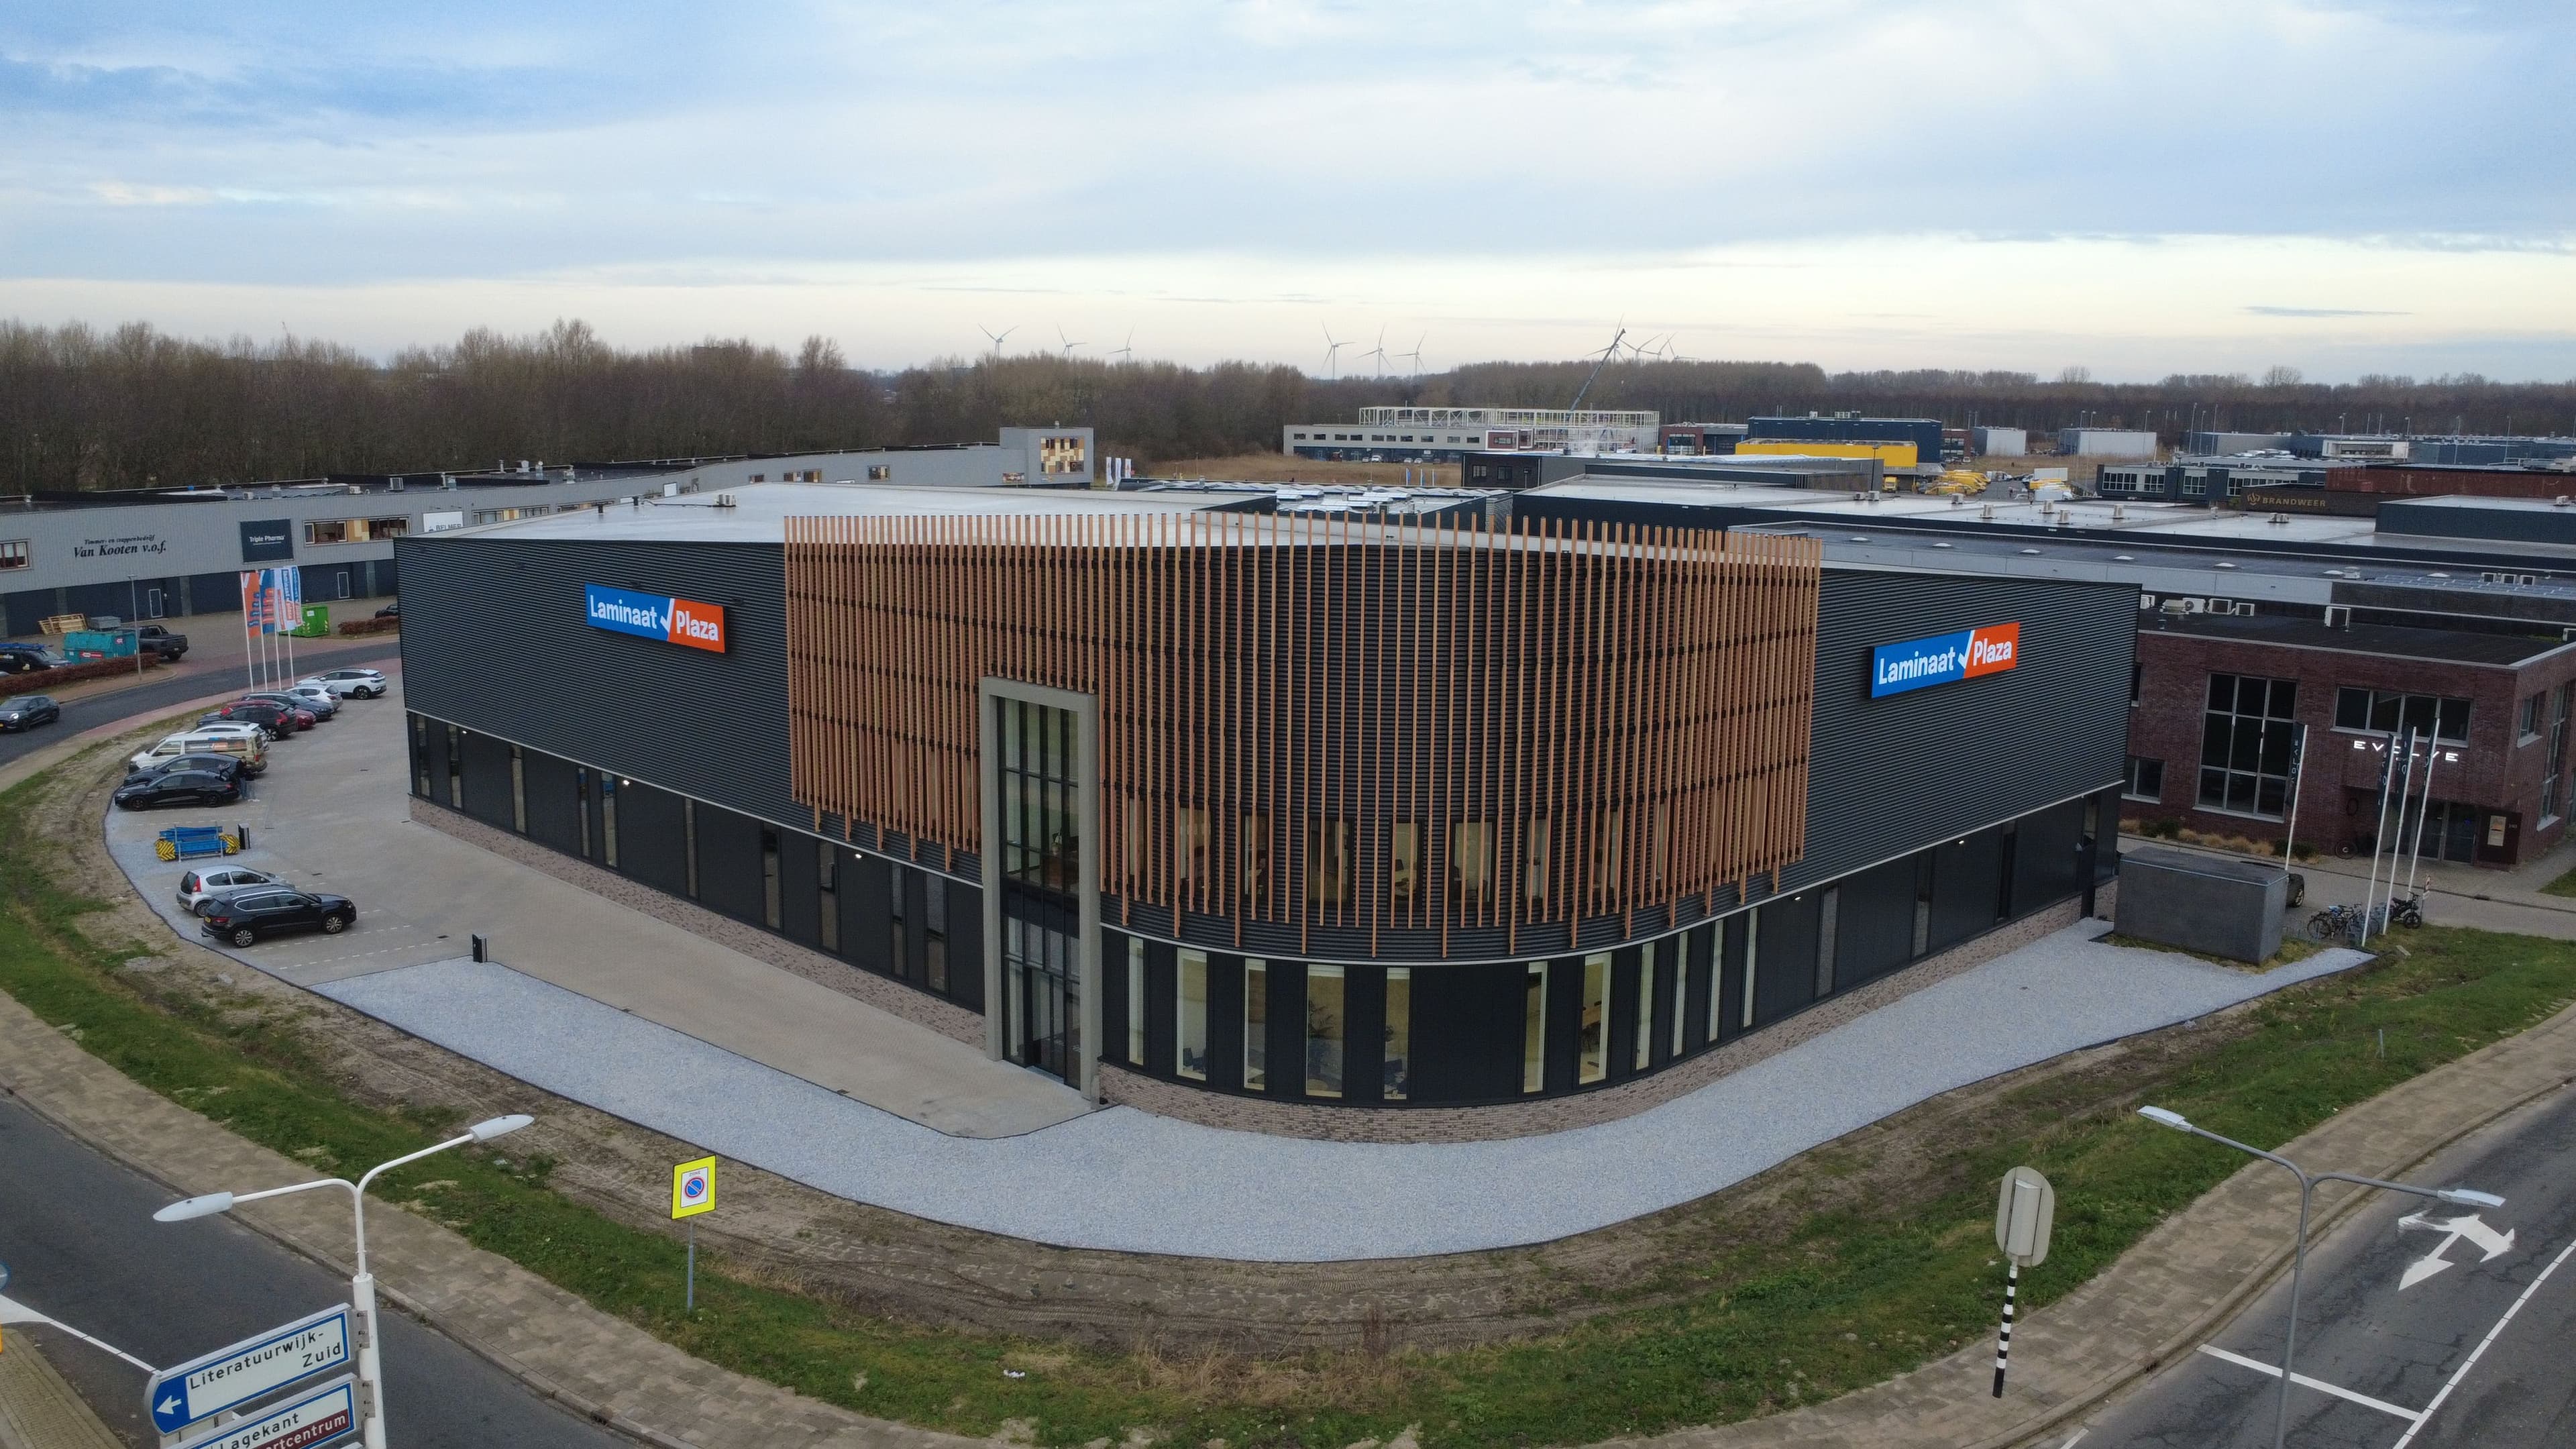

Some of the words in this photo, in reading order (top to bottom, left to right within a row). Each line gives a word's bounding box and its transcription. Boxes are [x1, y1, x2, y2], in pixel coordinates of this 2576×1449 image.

[2262, 498, 2326, 507] BRANDWEER
[74, 547, 95, 558] Van
[99, 544, 138, 556] Kooten
[142, 540, 166, 554] v.o.f.
[590, 594, 657, 629] Laminaat
[676, 610, 719, 641] Plaza
[1878, 646, 1955, 684] Laminaat
[1972, 638, 2012, 666] Plaza
[190, 1331, 324, 1389] Literatuurwijk-
[303, 1342, 341, 1368] Zuid
